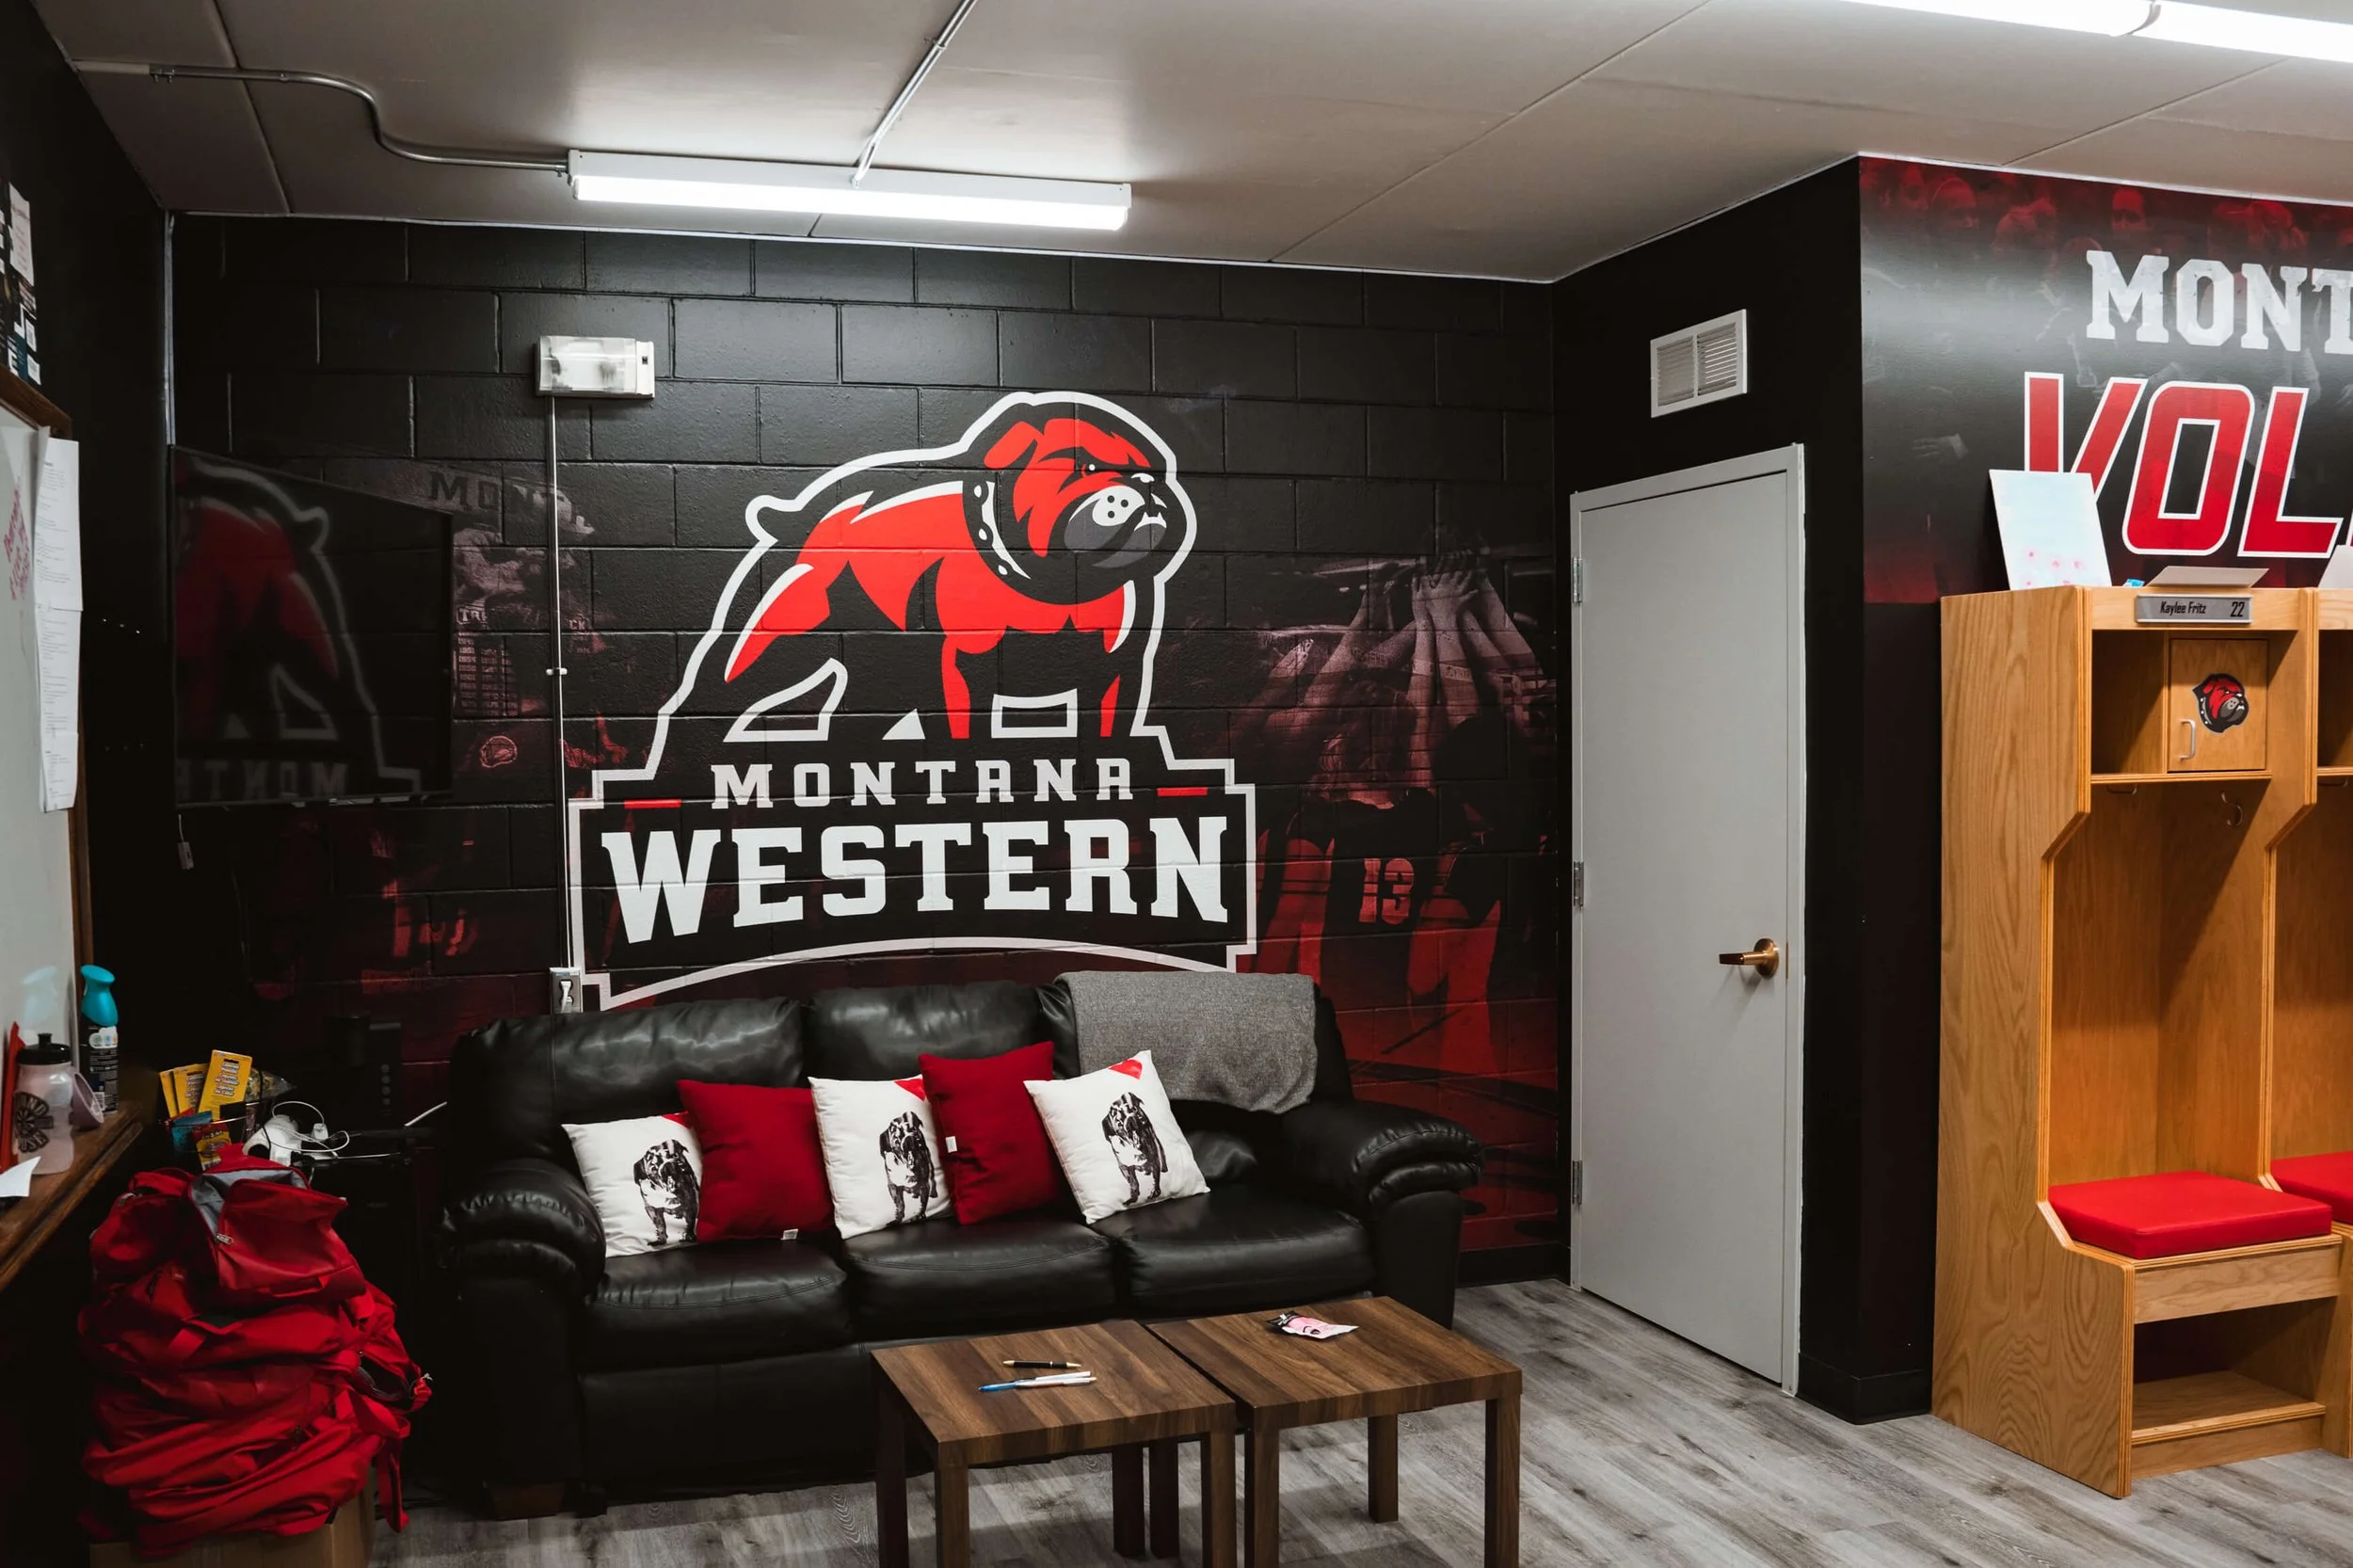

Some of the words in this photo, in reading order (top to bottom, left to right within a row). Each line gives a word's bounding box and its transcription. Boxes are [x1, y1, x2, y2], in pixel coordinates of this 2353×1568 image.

[2086, 249, 2353, 355] MONT
[2025, 371, 2353, 558] VOL
[2160, 600, 2185, 616] Kaylee
[2187, 601, 2207, 614] Fritz
[2230, 600, 2246, 617] 22
[711, 758, 1134, 809] MONTANA
[601, 816, 1228, 944] WESTERN
[1358, 857, 1415, 925] 13
